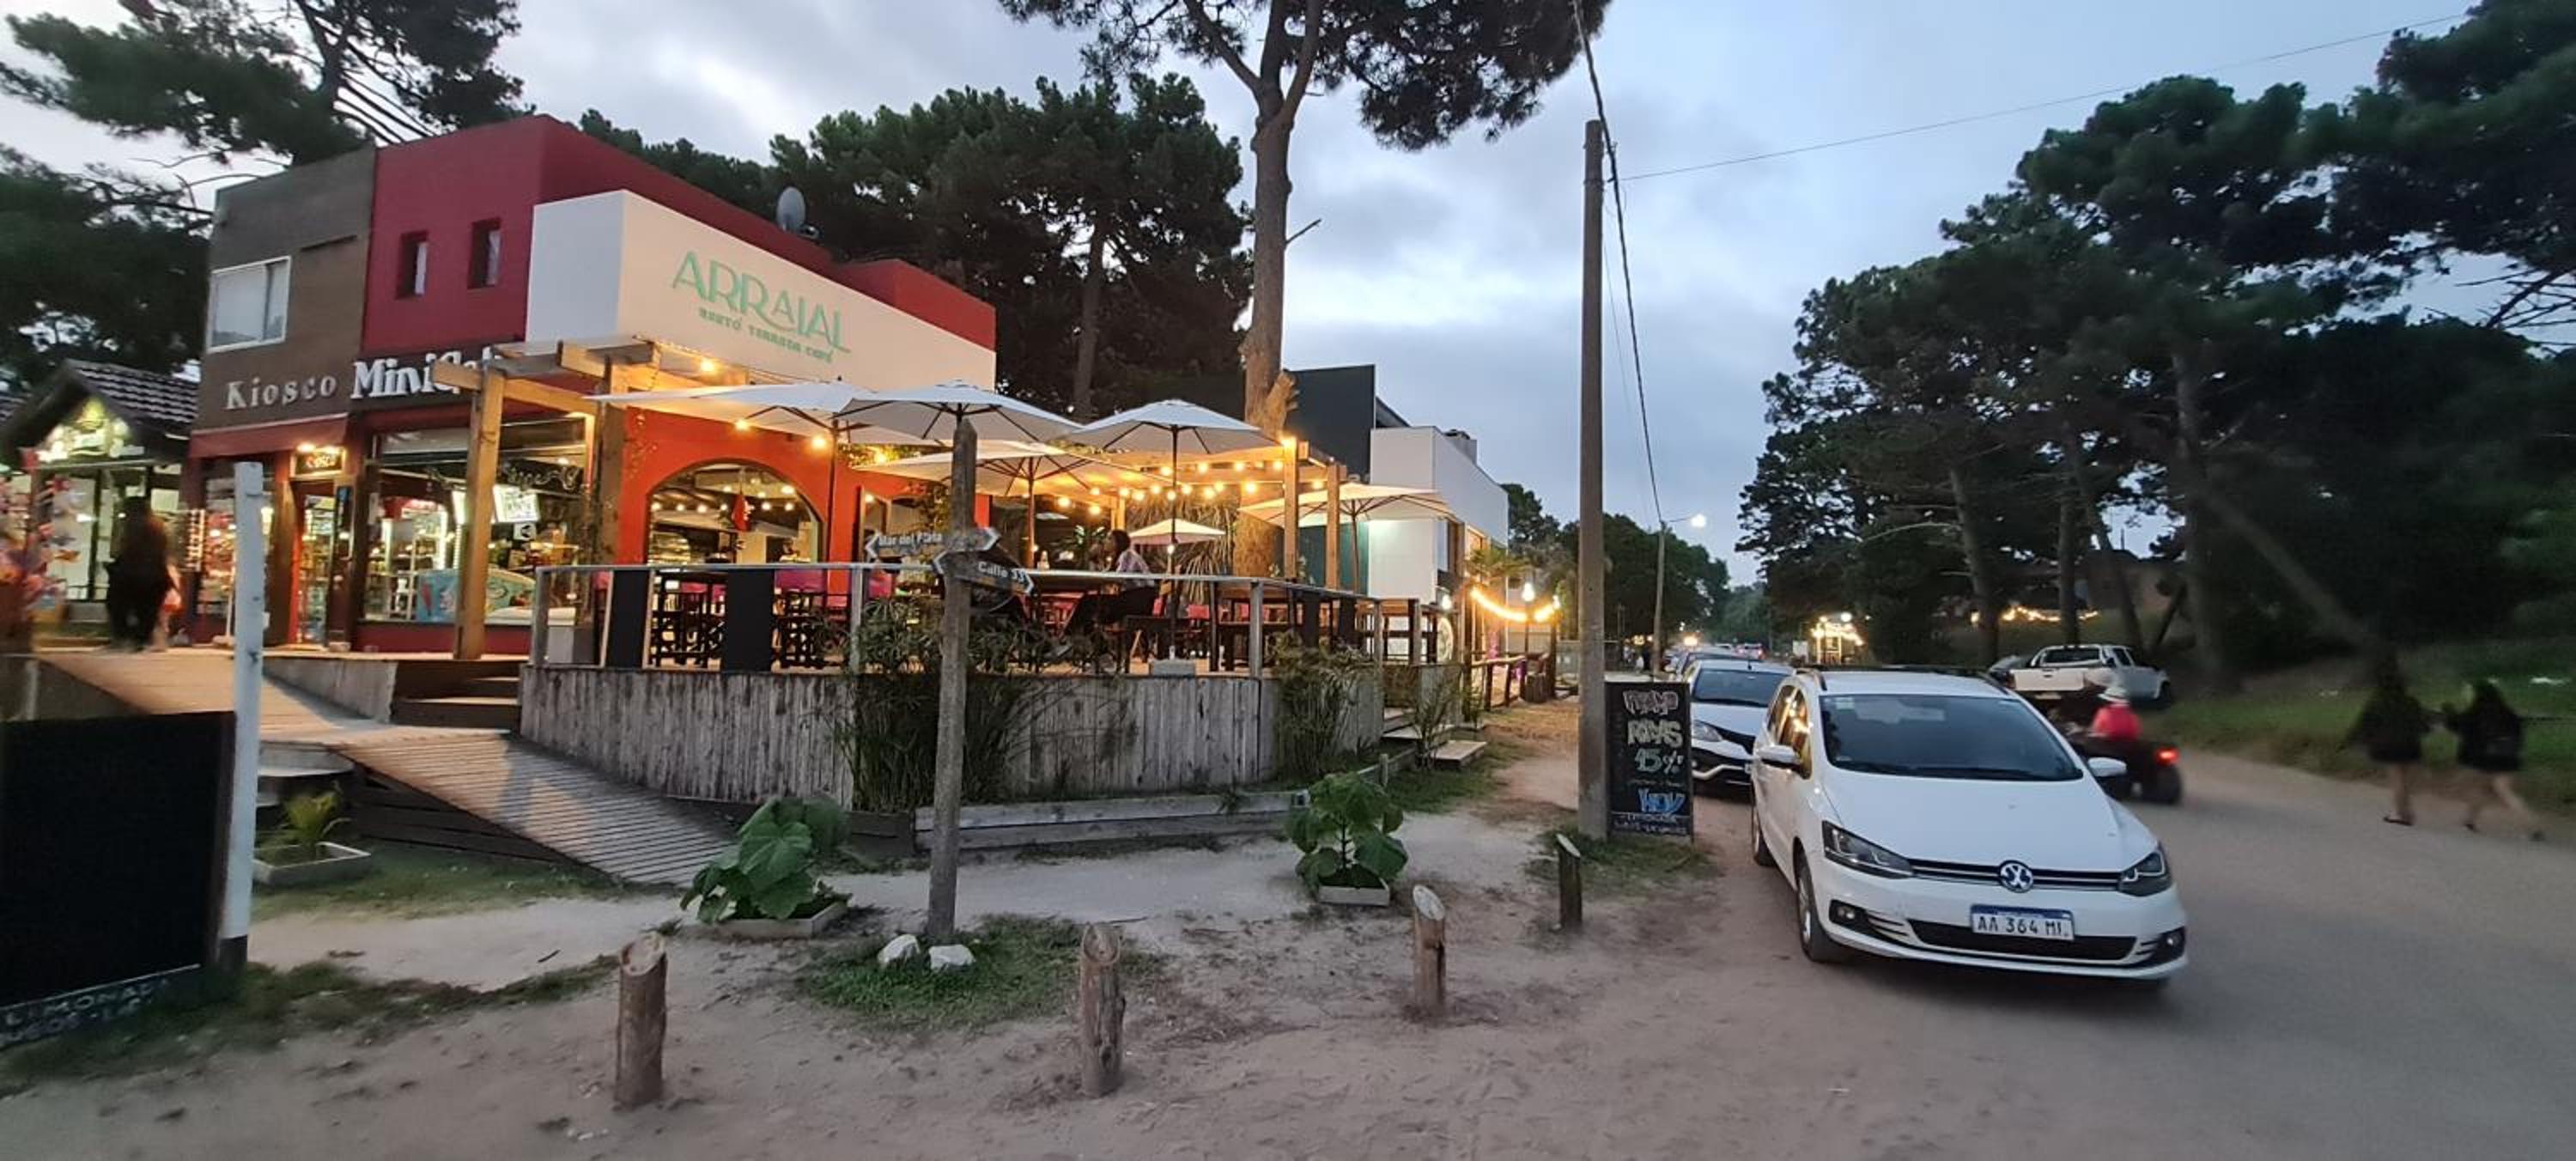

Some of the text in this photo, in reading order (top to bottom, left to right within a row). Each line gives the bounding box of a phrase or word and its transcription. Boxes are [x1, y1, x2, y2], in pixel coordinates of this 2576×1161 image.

[672, 251, 852, 354] ARRAIAL
[224, 375, 337, 410] Kiosco
[978, 561, 1008, 578] Calle
[2005, 916, 2038, 934] 364
